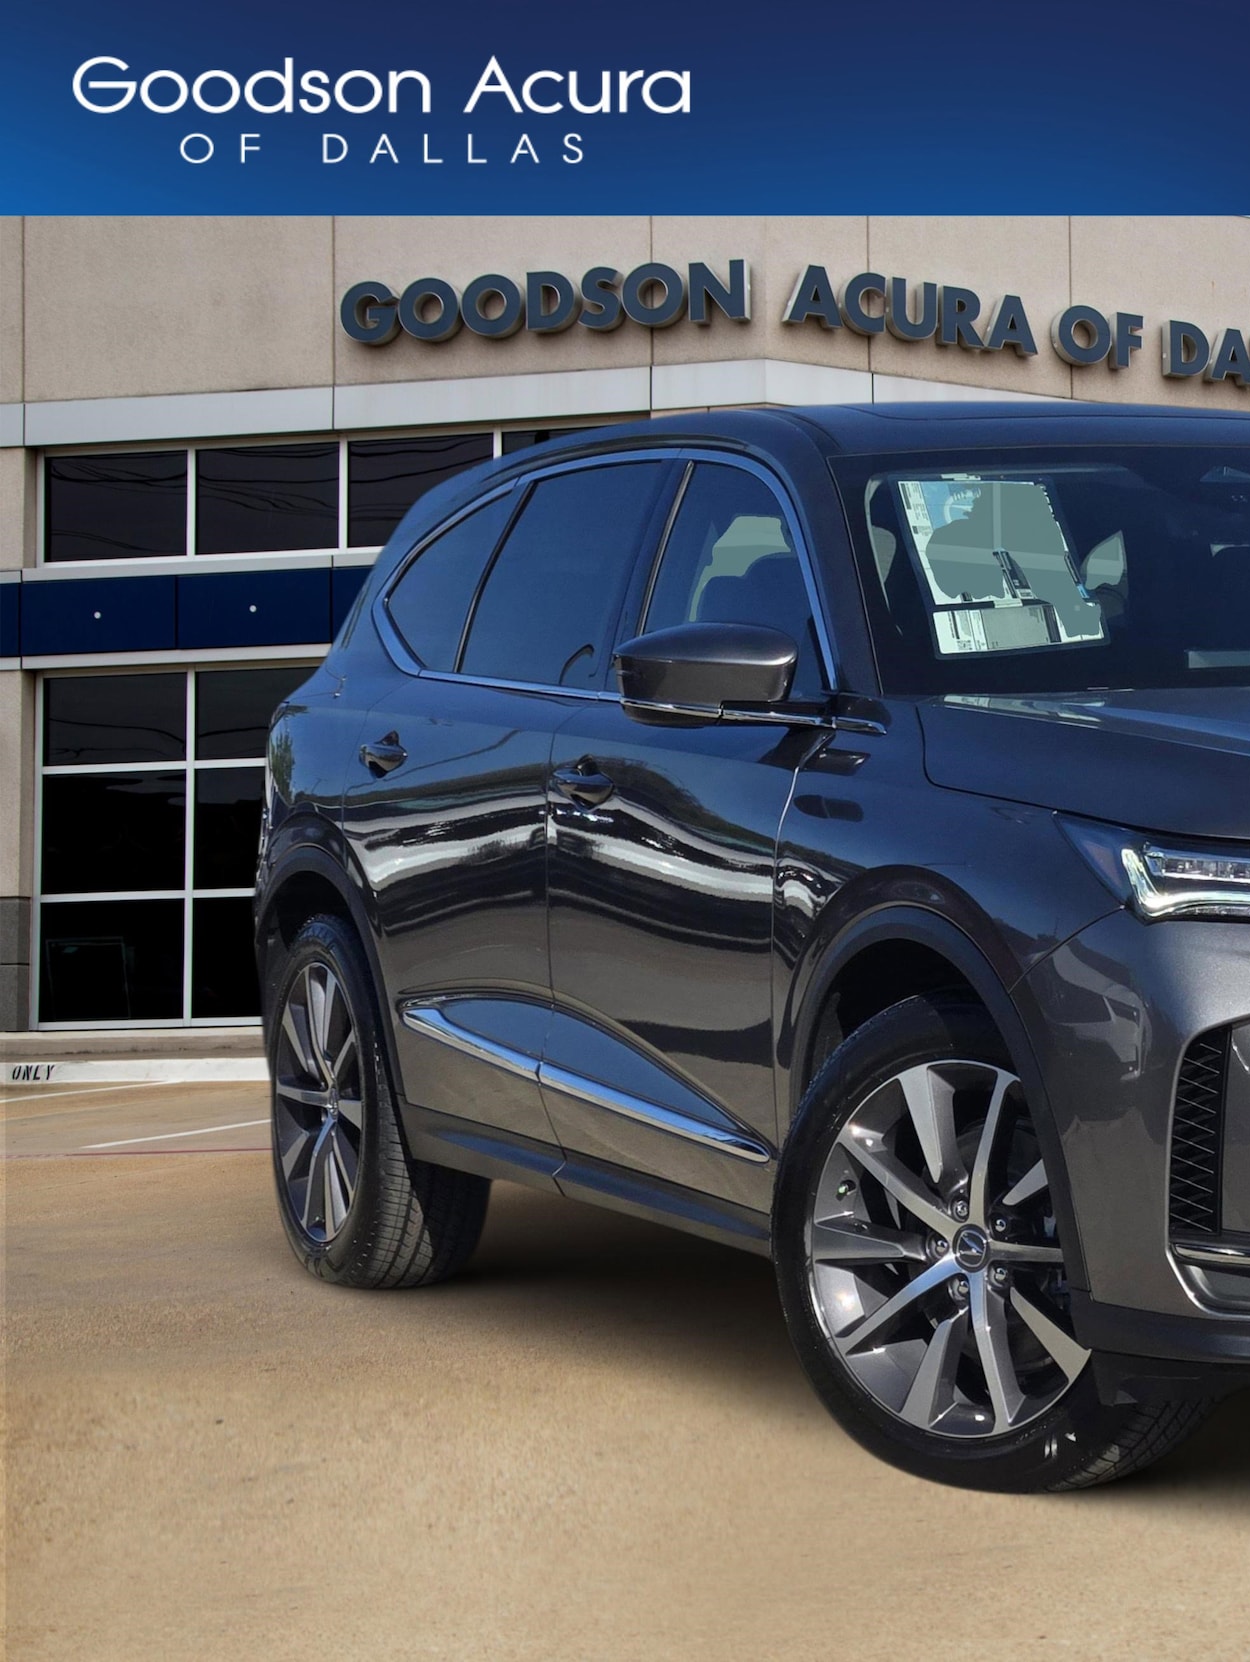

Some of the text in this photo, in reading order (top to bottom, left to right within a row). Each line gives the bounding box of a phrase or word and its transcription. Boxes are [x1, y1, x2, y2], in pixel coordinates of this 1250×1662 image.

[340, 259, 751, 345] GOODSON
[782, 264, 1038, 356] ACURA
[1051, 305, 1144, 369] OF
[12, 1065, 55, 1081] ONLY
